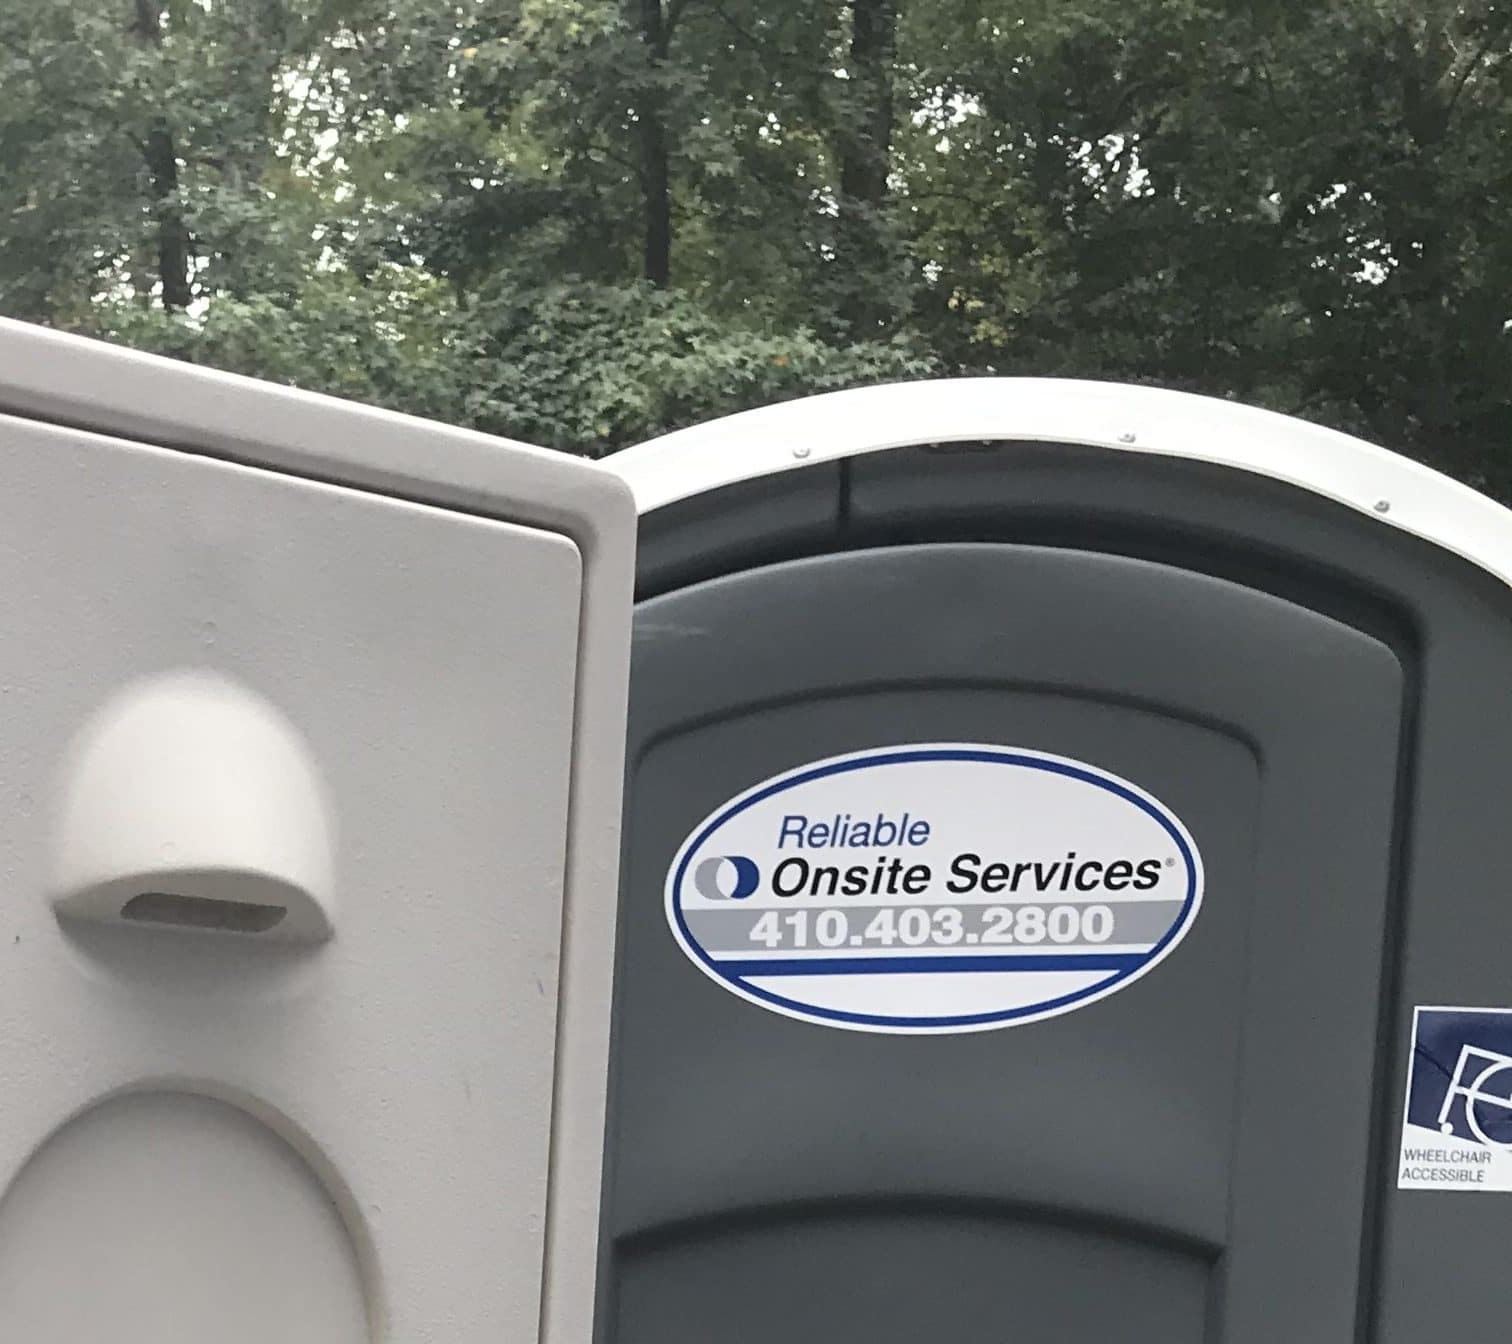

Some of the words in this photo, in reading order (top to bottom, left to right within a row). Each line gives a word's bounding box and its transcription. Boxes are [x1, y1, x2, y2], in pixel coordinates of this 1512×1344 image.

[777, 813, 930, 848] Reliable
[771, 855, 931, 898] Onsite
[945, 852, 1161, 893] Services
[749, 905, 1115, 947] 410.403.2800
[1404, 1149, 1492, 1164] WHEELCHAIR
[1401, 1167, 1485, 1183] ACCESSIBLE
